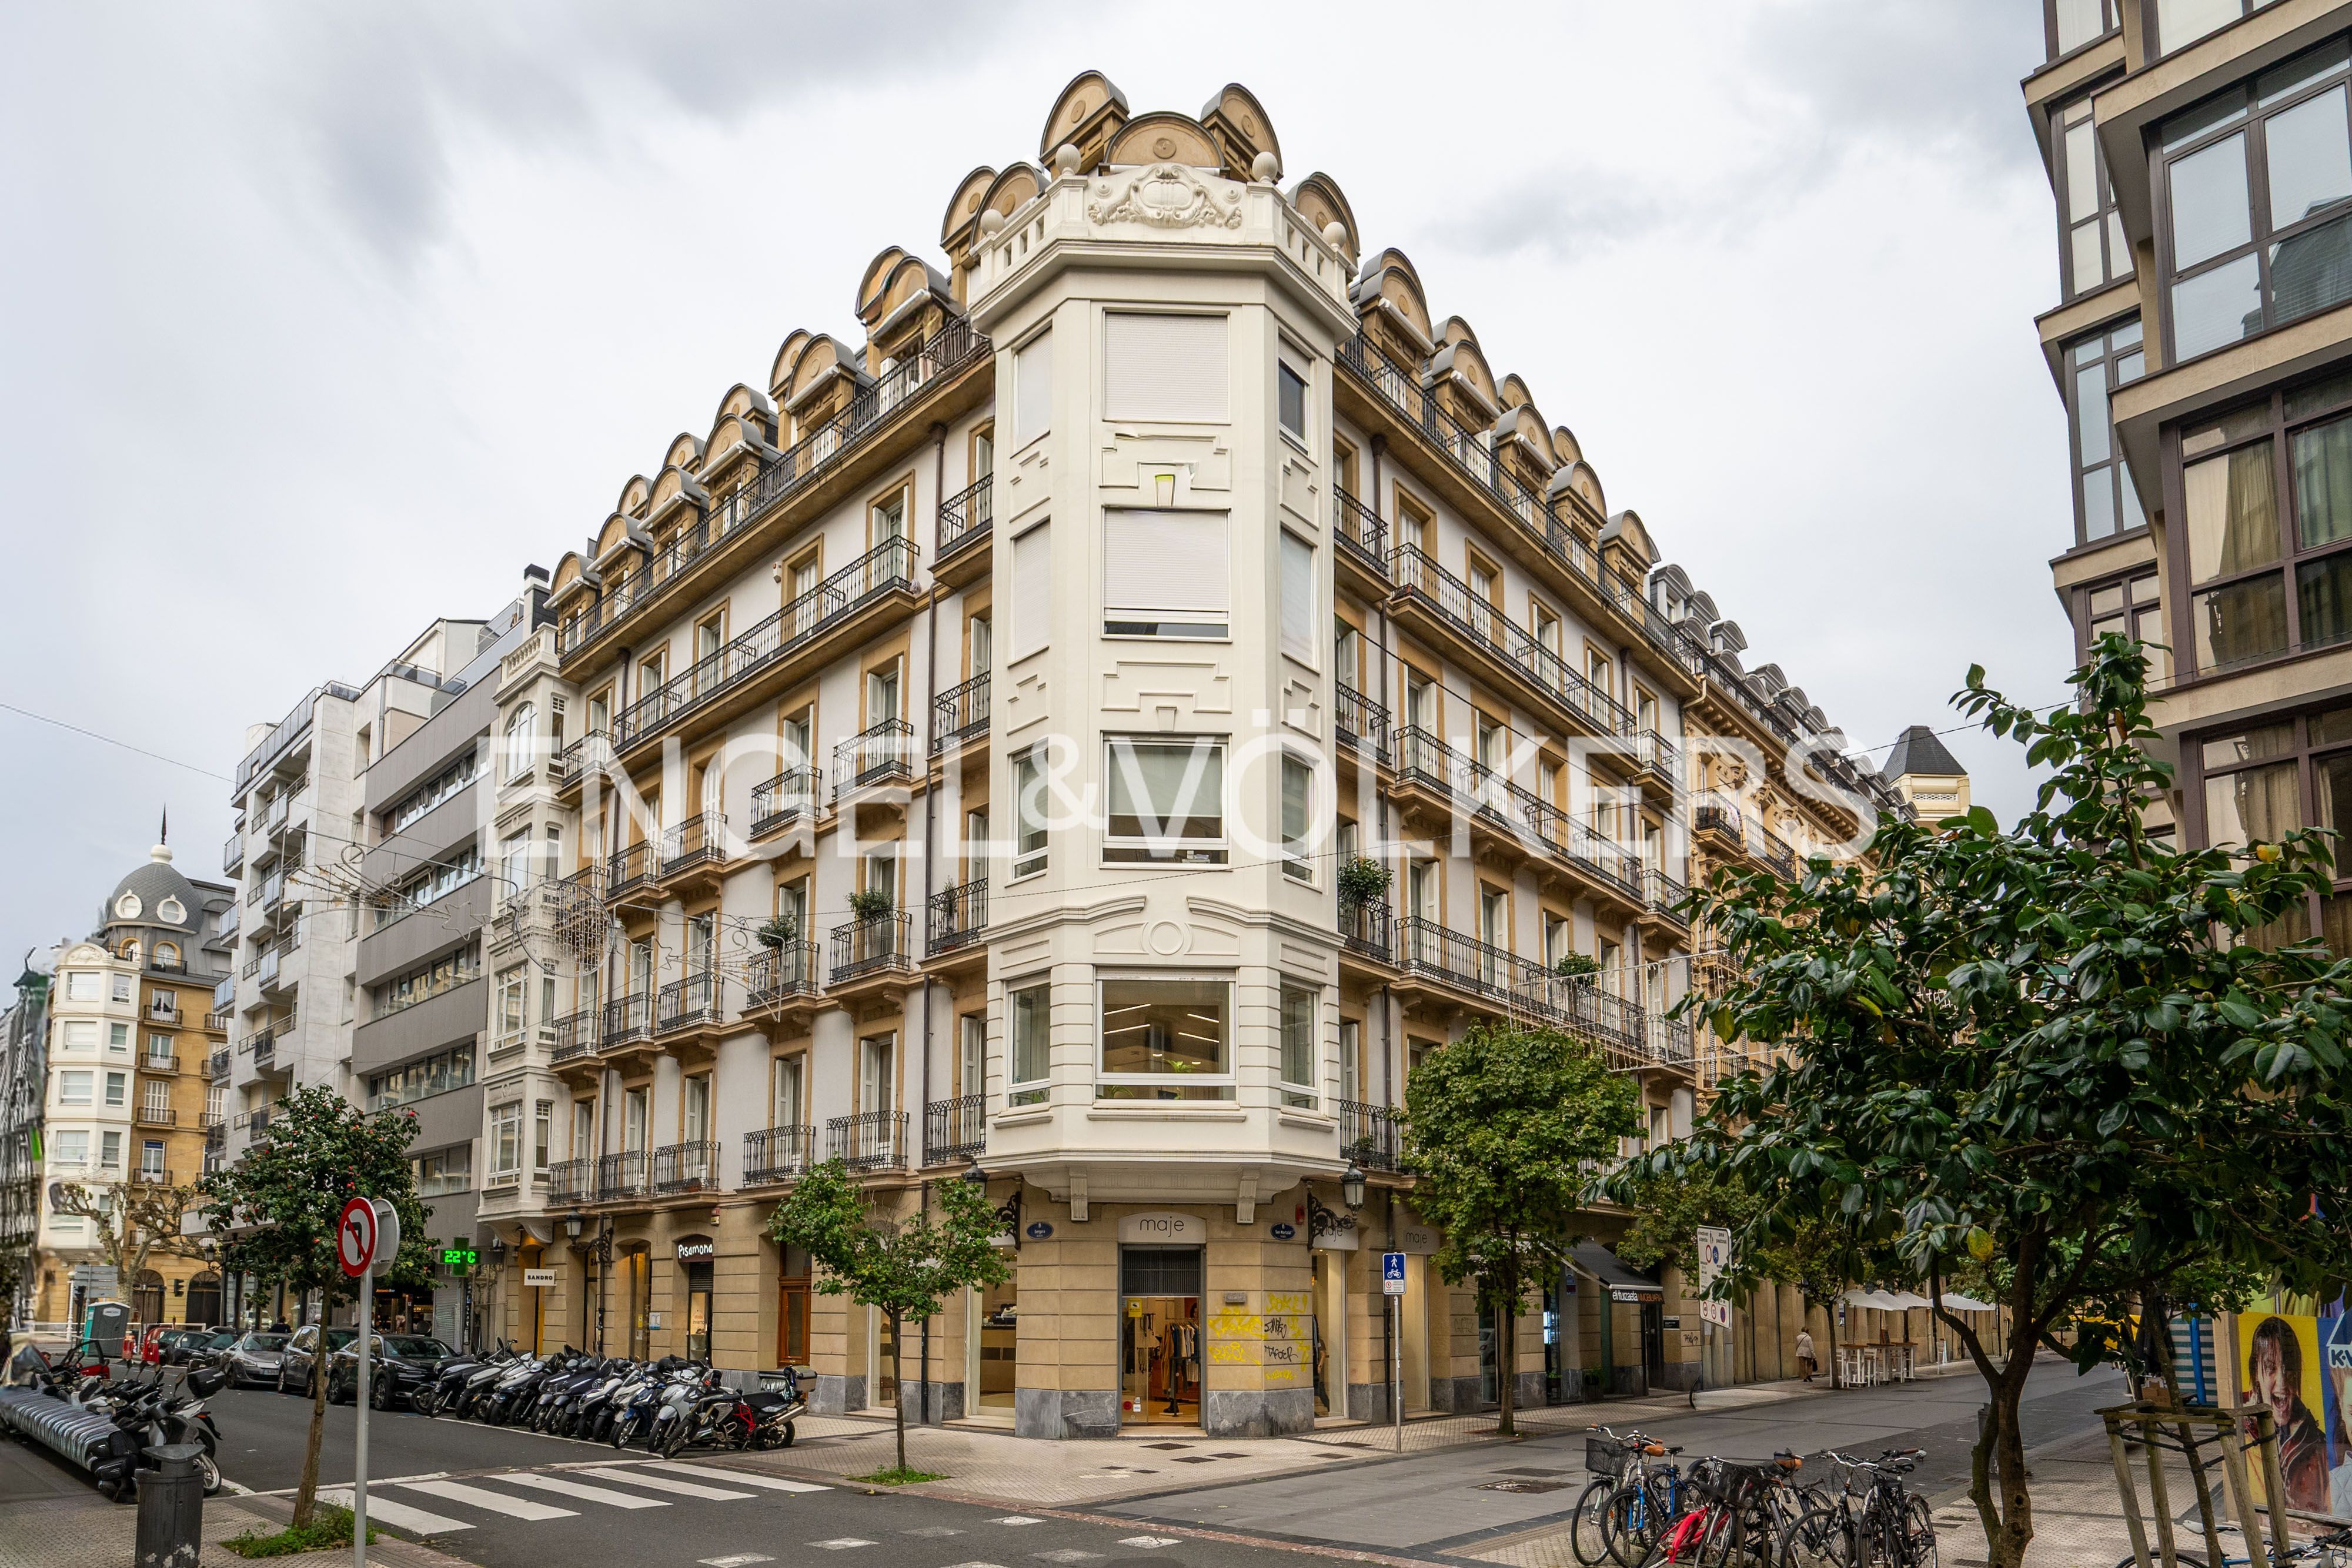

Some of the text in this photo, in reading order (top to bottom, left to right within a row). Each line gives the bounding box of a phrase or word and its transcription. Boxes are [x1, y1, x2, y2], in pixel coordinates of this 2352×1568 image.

[1140, 1216, 1184, 1237] maje
[1406, 1231, 1428, 1248] maje
[678, 1243, 713, 1259] Pisamona
